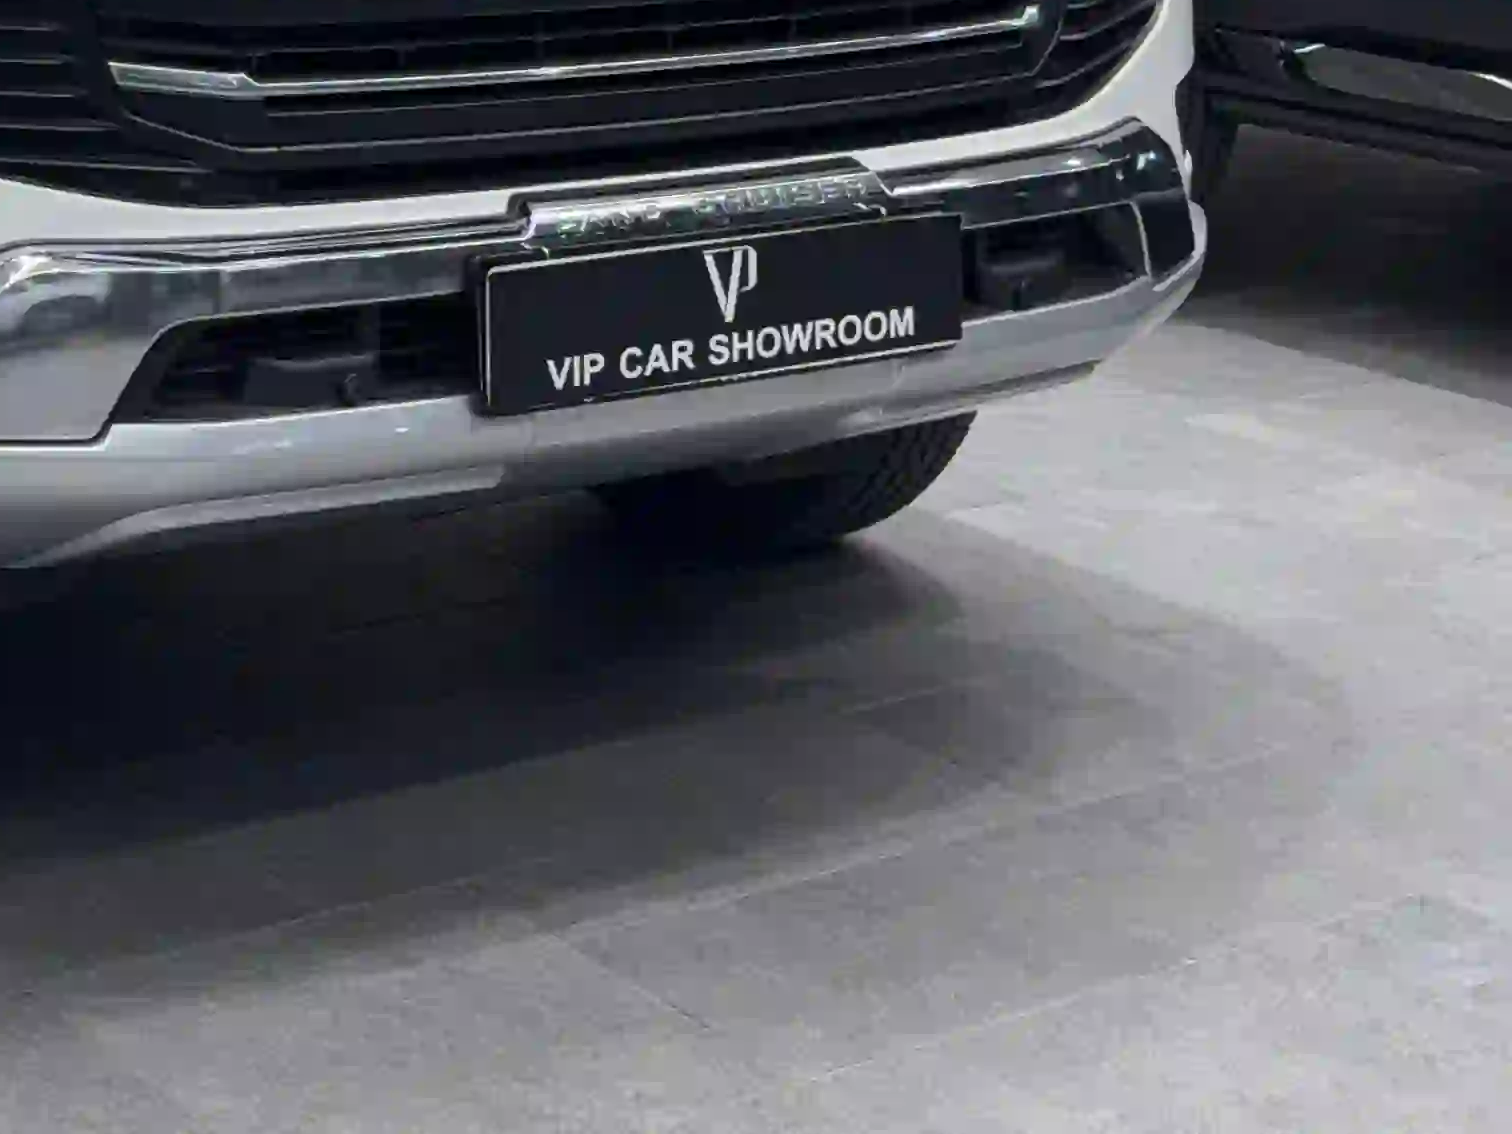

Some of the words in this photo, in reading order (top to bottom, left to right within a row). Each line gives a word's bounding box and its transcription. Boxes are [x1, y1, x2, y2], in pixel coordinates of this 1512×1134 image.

[546, 352, 605, 391] VIP
[619, 339, 696, 379] CAR
[708, 306, 915, 366] SHOWROOM
